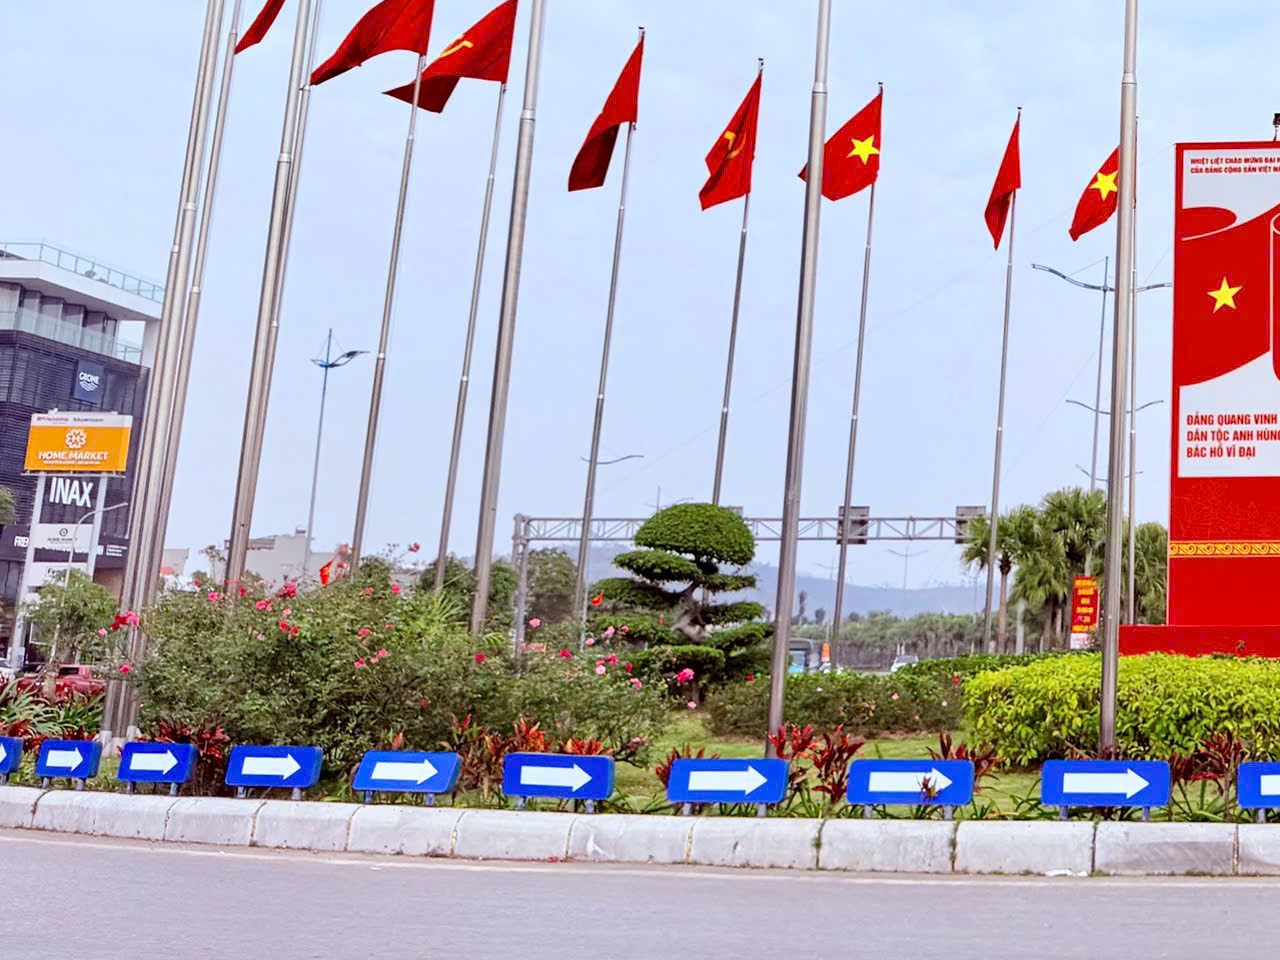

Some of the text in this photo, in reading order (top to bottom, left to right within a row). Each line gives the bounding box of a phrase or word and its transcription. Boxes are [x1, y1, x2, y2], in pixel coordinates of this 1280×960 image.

[1186, 411, 1278, 426] ĐẢNG QUANG VINH
[1186, 428, 1208, 441] DÂN
[1210, 428, 1230, 443] TỘC
[1232, 430, 1253, 441] ANH
[38, 451, 109, 461] HOME MARKET
[1186, 443, 1256, 460] BÁC HỒ VĨ ĐẠI
[49, 477, 94, 508] INAX
